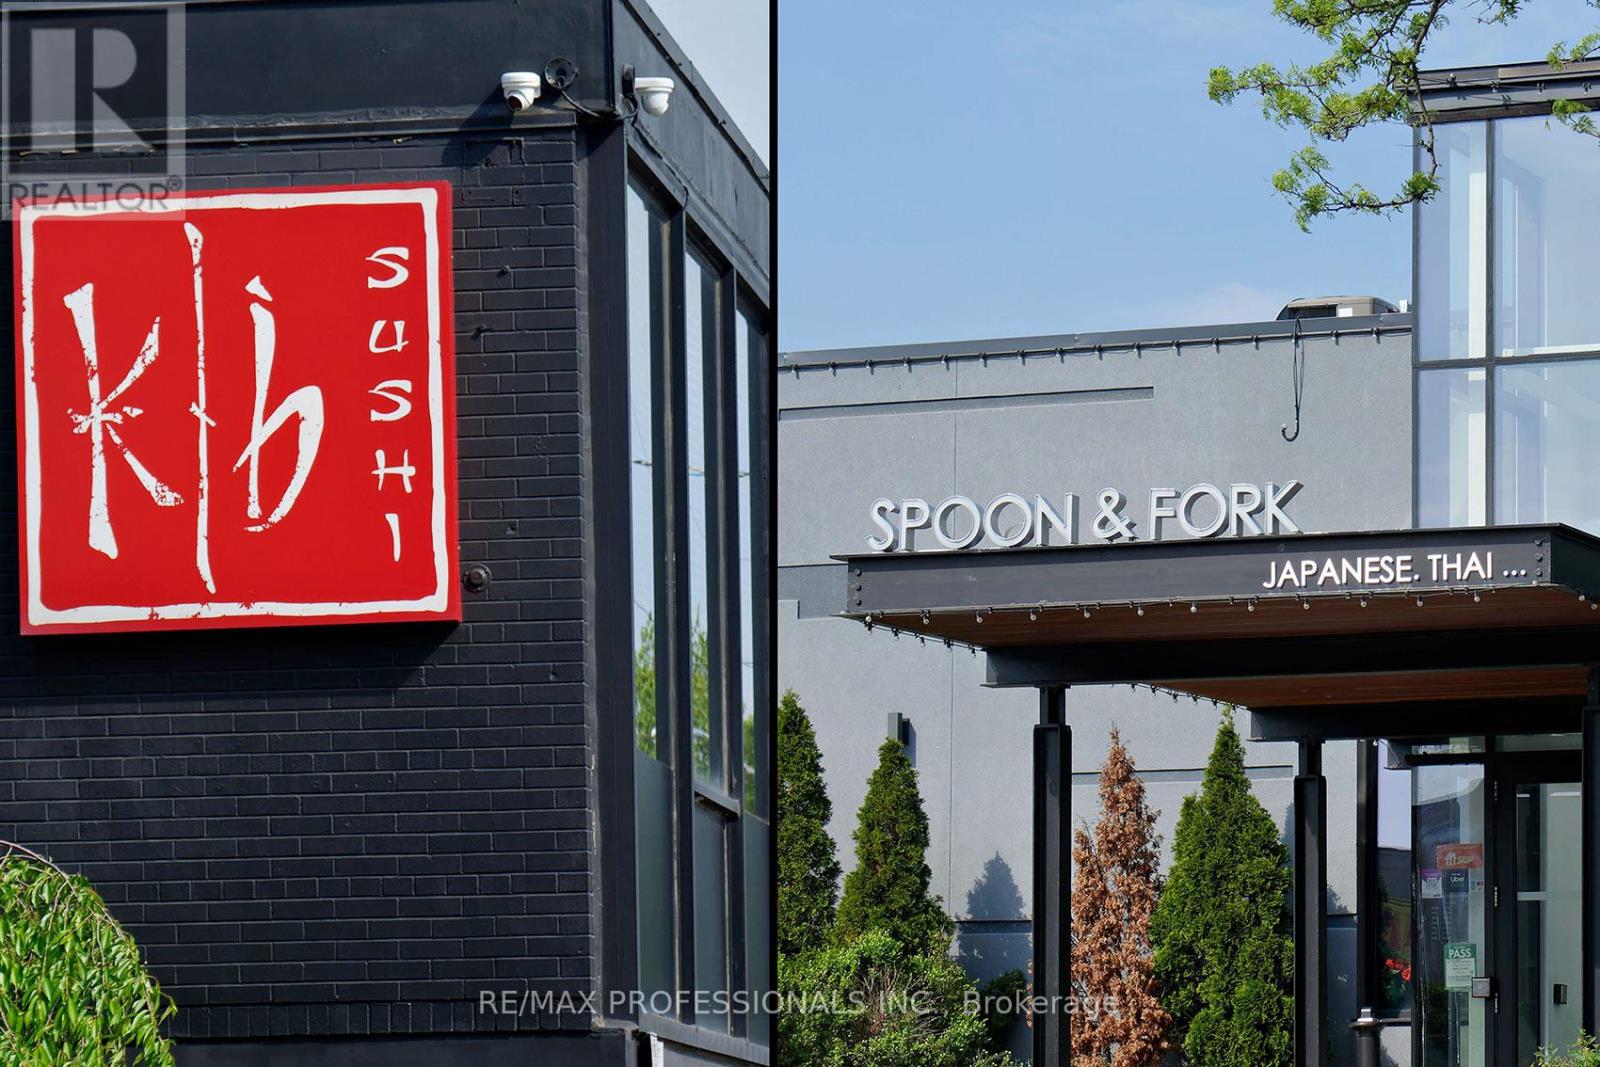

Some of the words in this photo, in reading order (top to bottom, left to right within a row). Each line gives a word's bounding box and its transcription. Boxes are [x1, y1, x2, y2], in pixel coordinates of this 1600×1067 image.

[365, 246, 416, 562] SUSHI
[866, 493, 1080, 551] SPOON
[1091, 487, 1137, 542] &
[1148, 480, 1304, 541] FORK
[1263, 554, 1420, 588] JAPANESE.
[1427, 551, 1493, 582] THAI
[1448, 948, 1472, 958] PASS
